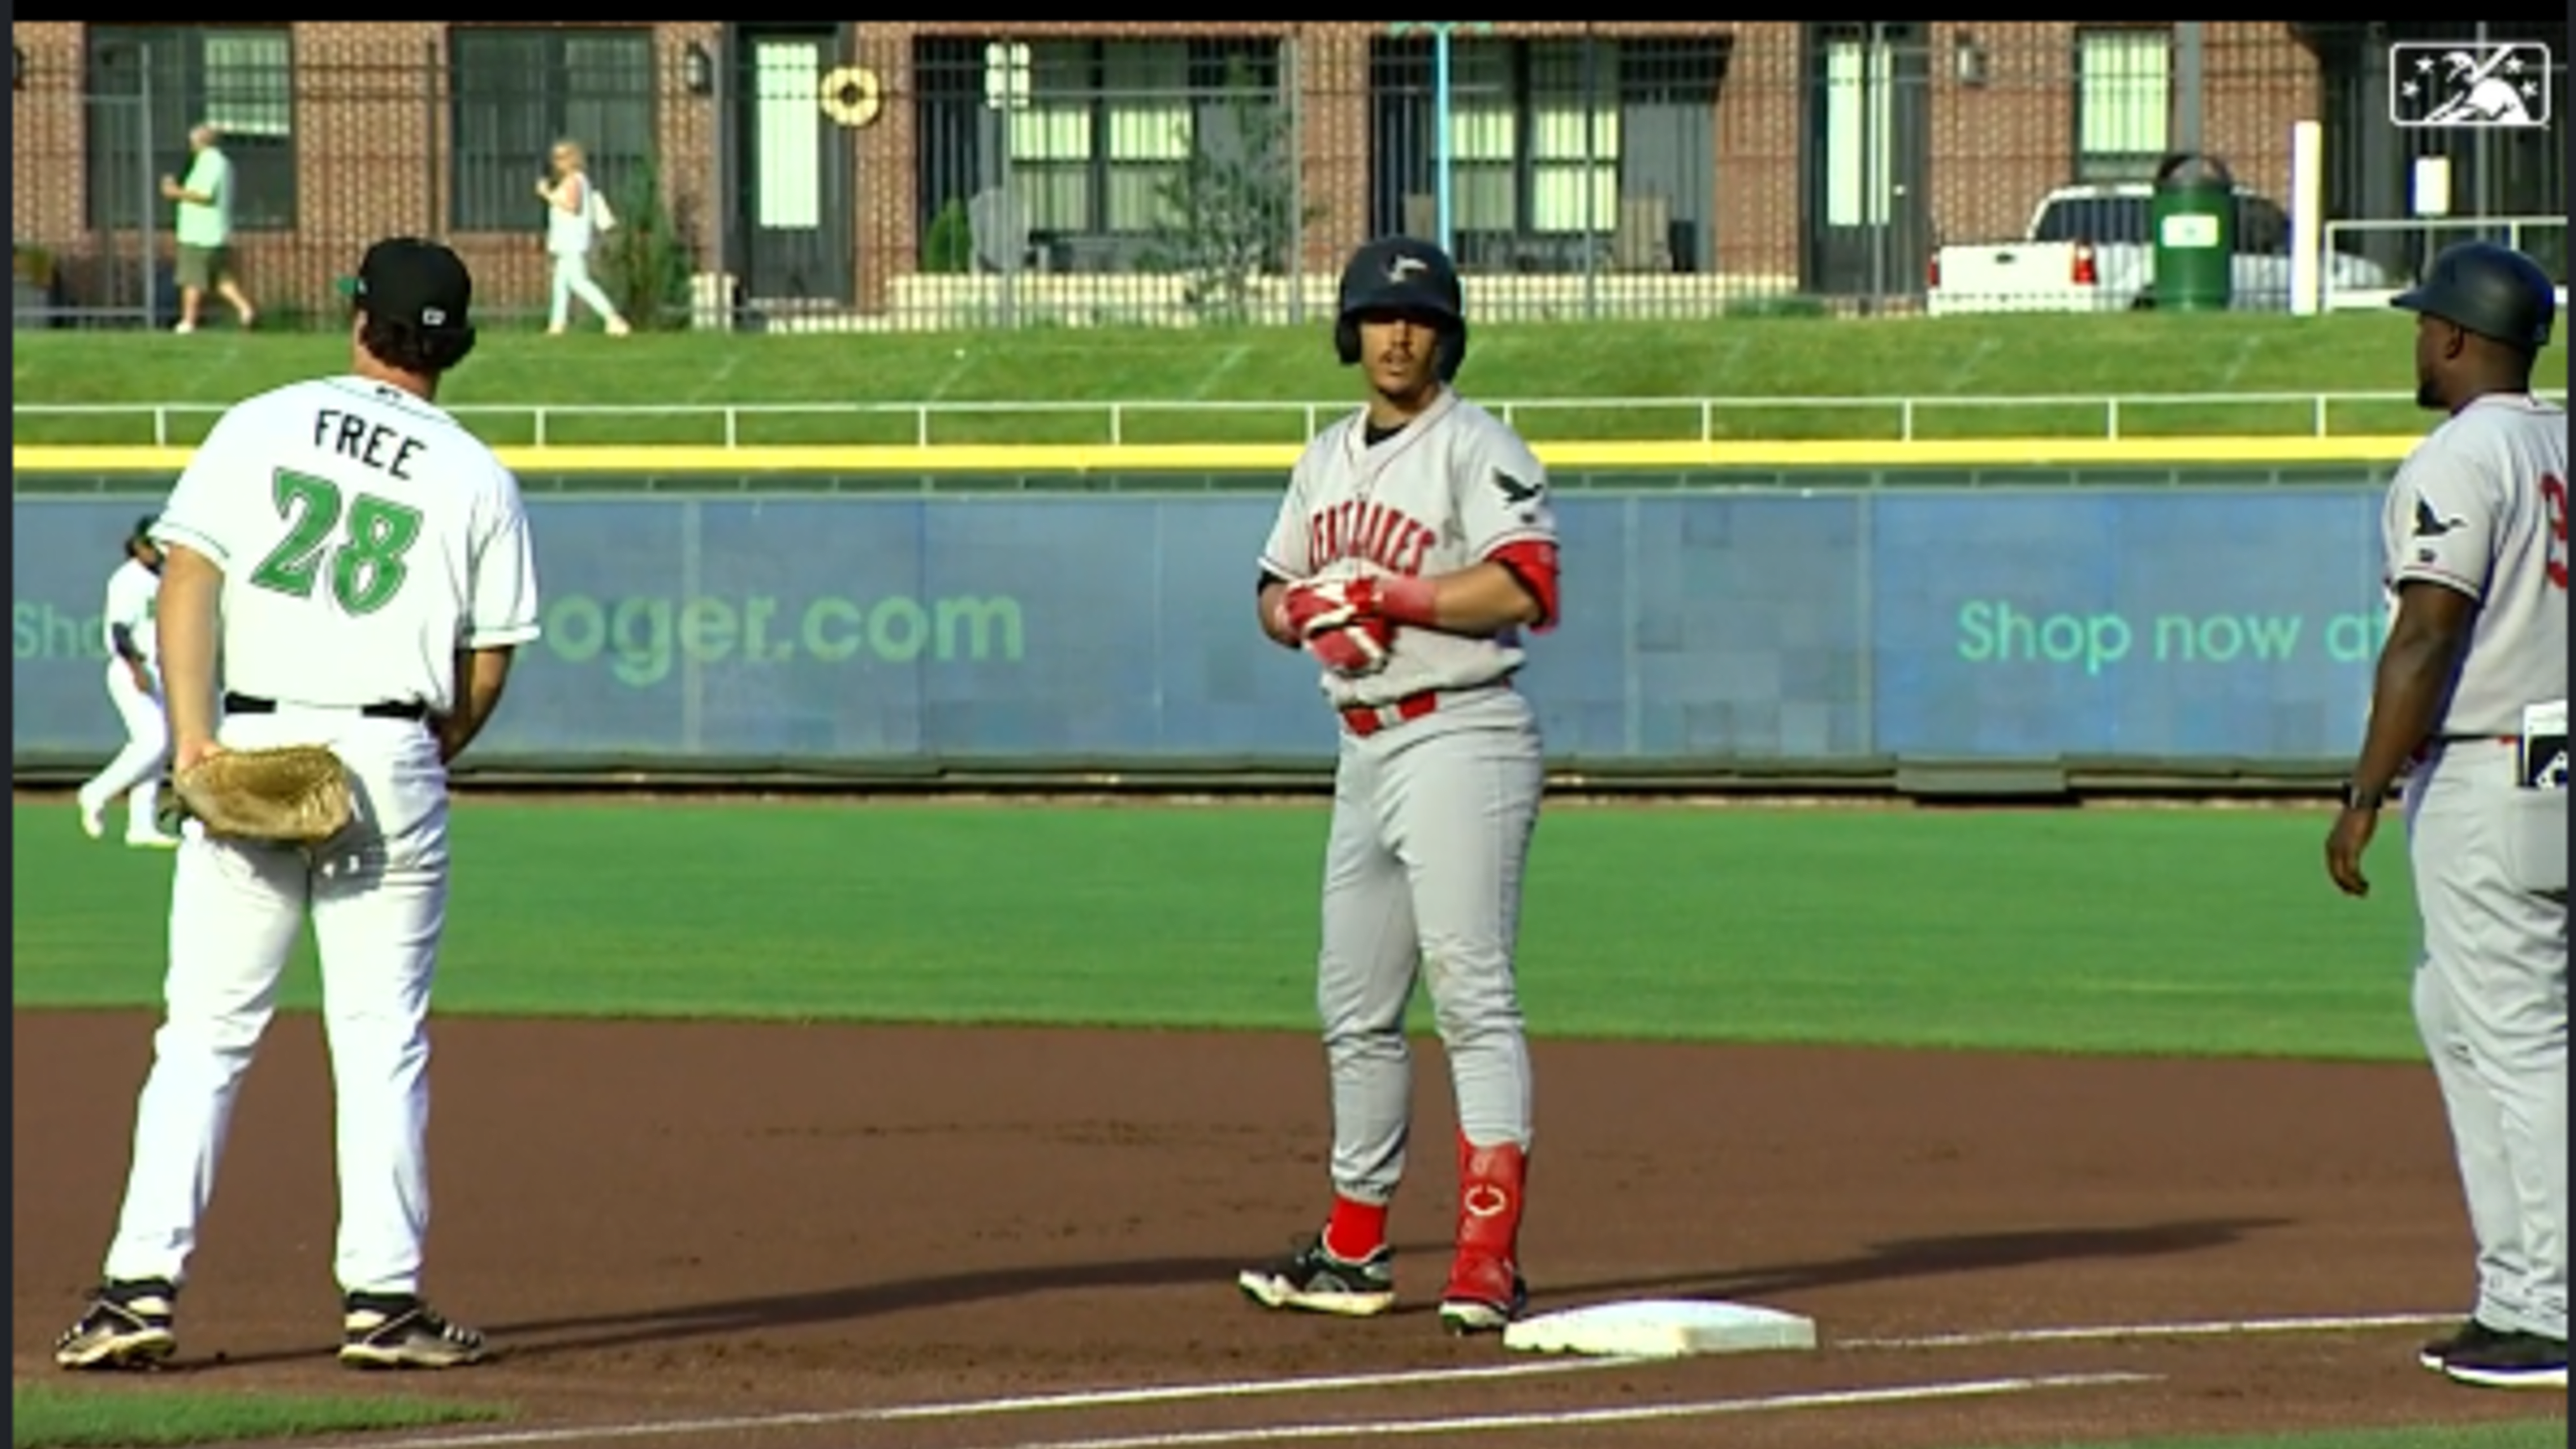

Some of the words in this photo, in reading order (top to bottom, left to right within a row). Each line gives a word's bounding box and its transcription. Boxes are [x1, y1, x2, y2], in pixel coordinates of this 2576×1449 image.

[314, 409, 428, 480] FREE
[248, 465, 423, 619] 28
[516, 595, 1025, 688] oger.com
[1958, 600, 2131, 674] Shop
[2155, 614, 2303, 660] now
